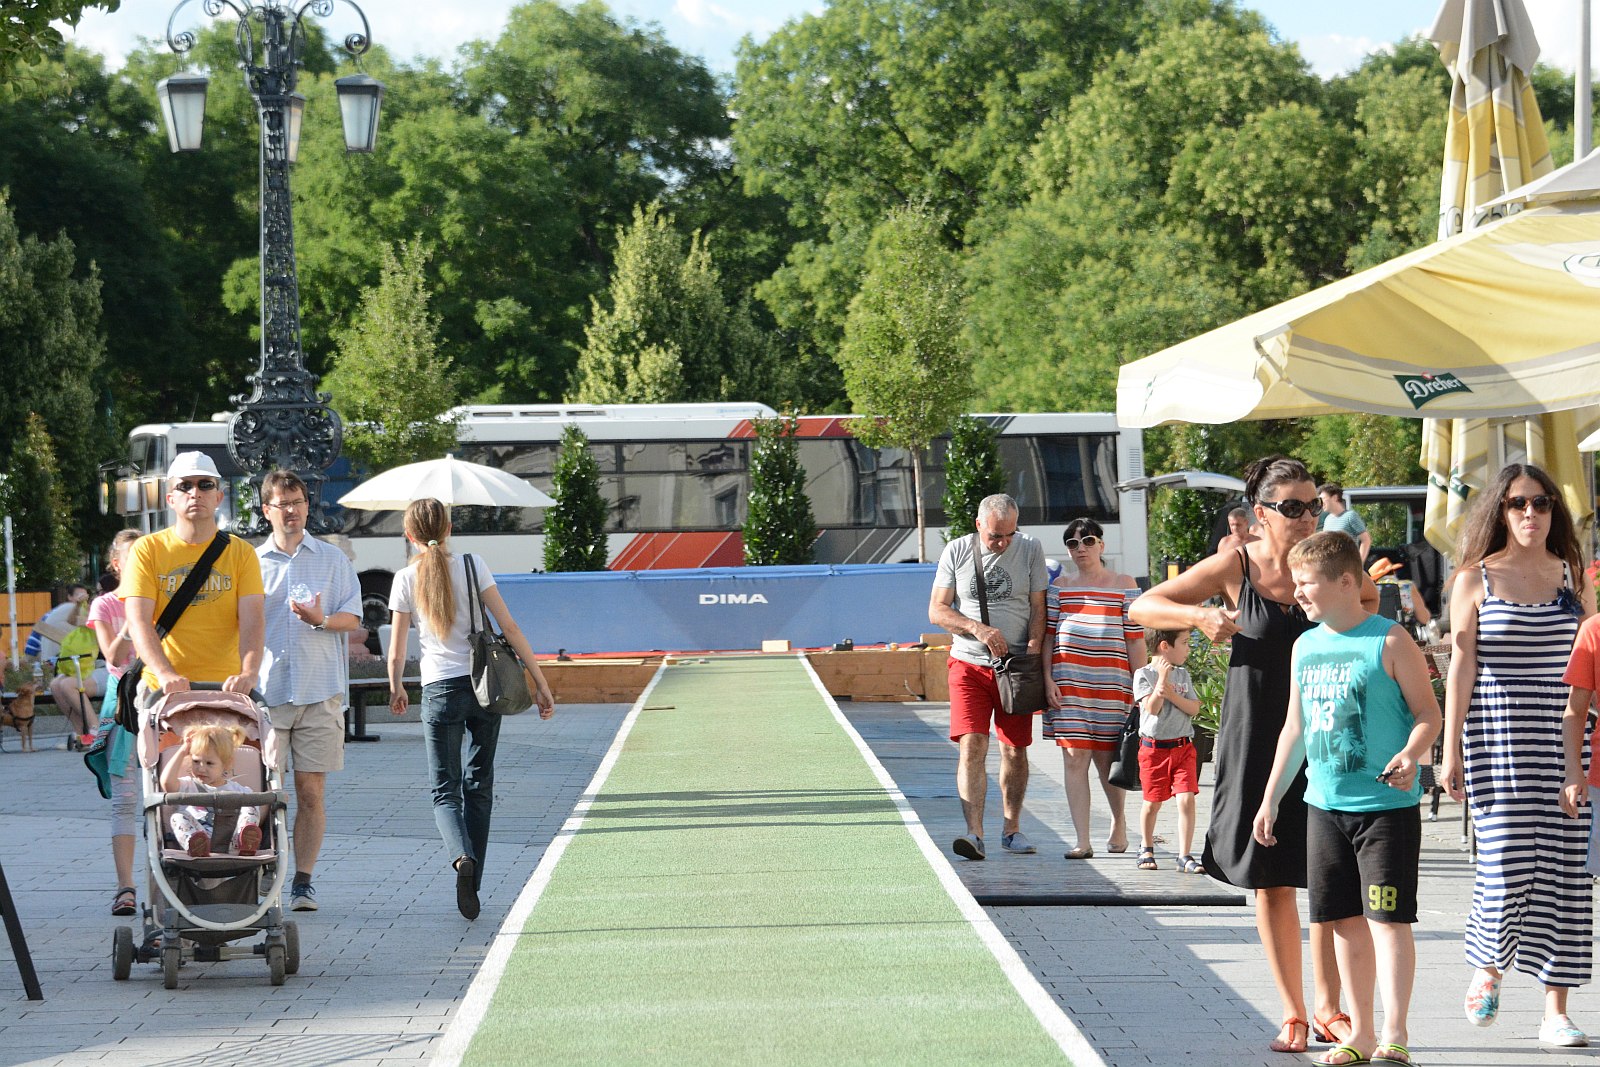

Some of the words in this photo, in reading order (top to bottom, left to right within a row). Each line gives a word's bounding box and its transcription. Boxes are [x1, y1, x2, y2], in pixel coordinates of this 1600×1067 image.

[1404, 376, 1462, 399] Dreher
[157, 574, 232, 592] TRING
[699, 593, 769, 605] DIMA
[1301, 667, 1352, 685] TROPICAL
[1368, 884, 1398, 912] 98
